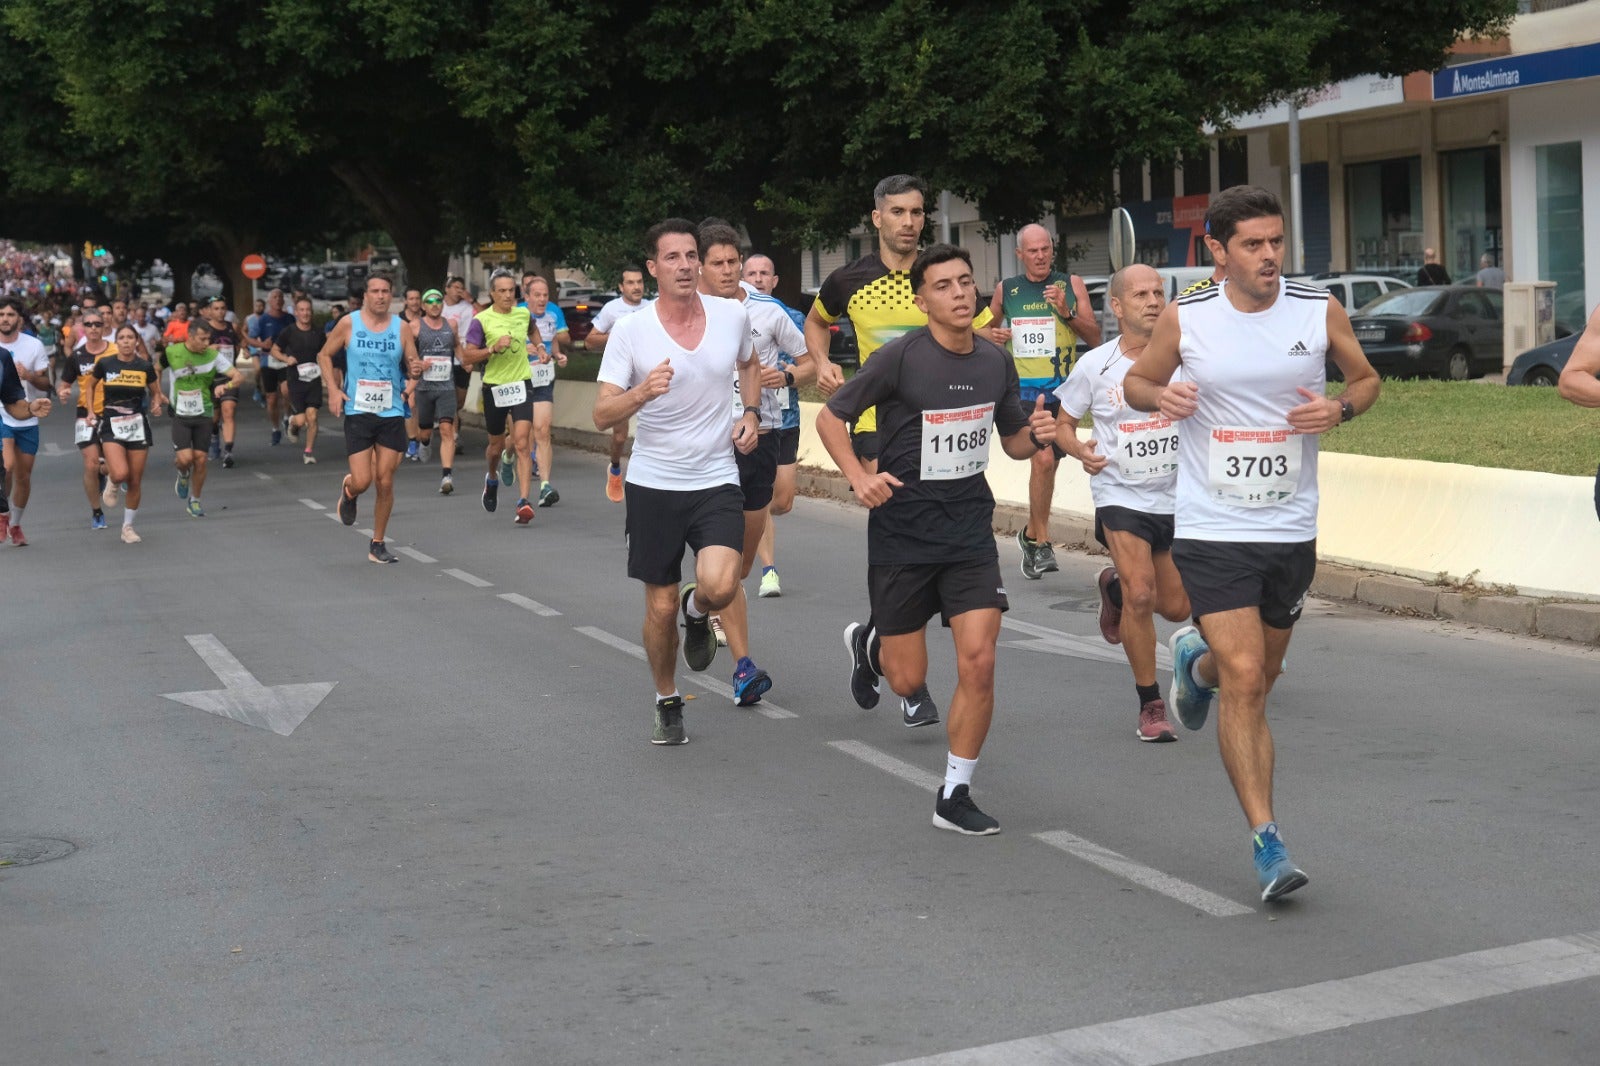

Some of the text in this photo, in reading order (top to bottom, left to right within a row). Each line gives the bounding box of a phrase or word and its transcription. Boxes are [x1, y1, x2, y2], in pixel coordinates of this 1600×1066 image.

[1461, 68, 1520, 92] MonteAlminara
[1022, 302, 1048, 310] cudeca
[1022, 332, 1045, 344] 189
[357, 338, 396, 352] nerja
[537, 369, 549, 377] 101
[365, 393, 384, 402] 244
[498, 385, 521, 397] 9935
[925, 413, 944, 424] 42
[930, 428, 987, 454] 11688
[1213, 429, 1234, 443] 42
[1125, 435, 1179, 458] 13978
[1226, 455, 1288, 477] 3703
